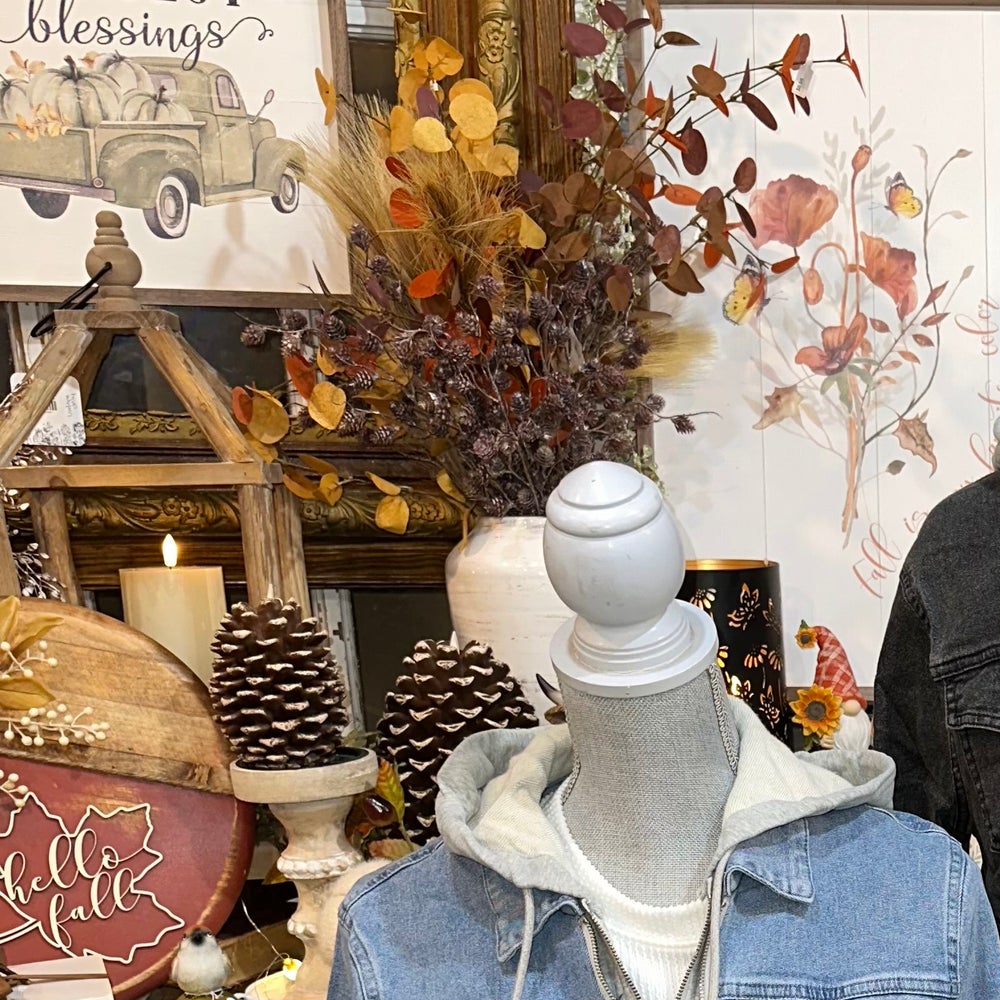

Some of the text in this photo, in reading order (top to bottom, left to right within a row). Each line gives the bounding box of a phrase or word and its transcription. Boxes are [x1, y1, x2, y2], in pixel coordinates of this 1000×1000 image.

[0, 0, 274, 71] blessings
[853, 522, 903, 599] Fall
[3, 828, 145, 904] hello
[50, 867, 140, 949] fall
